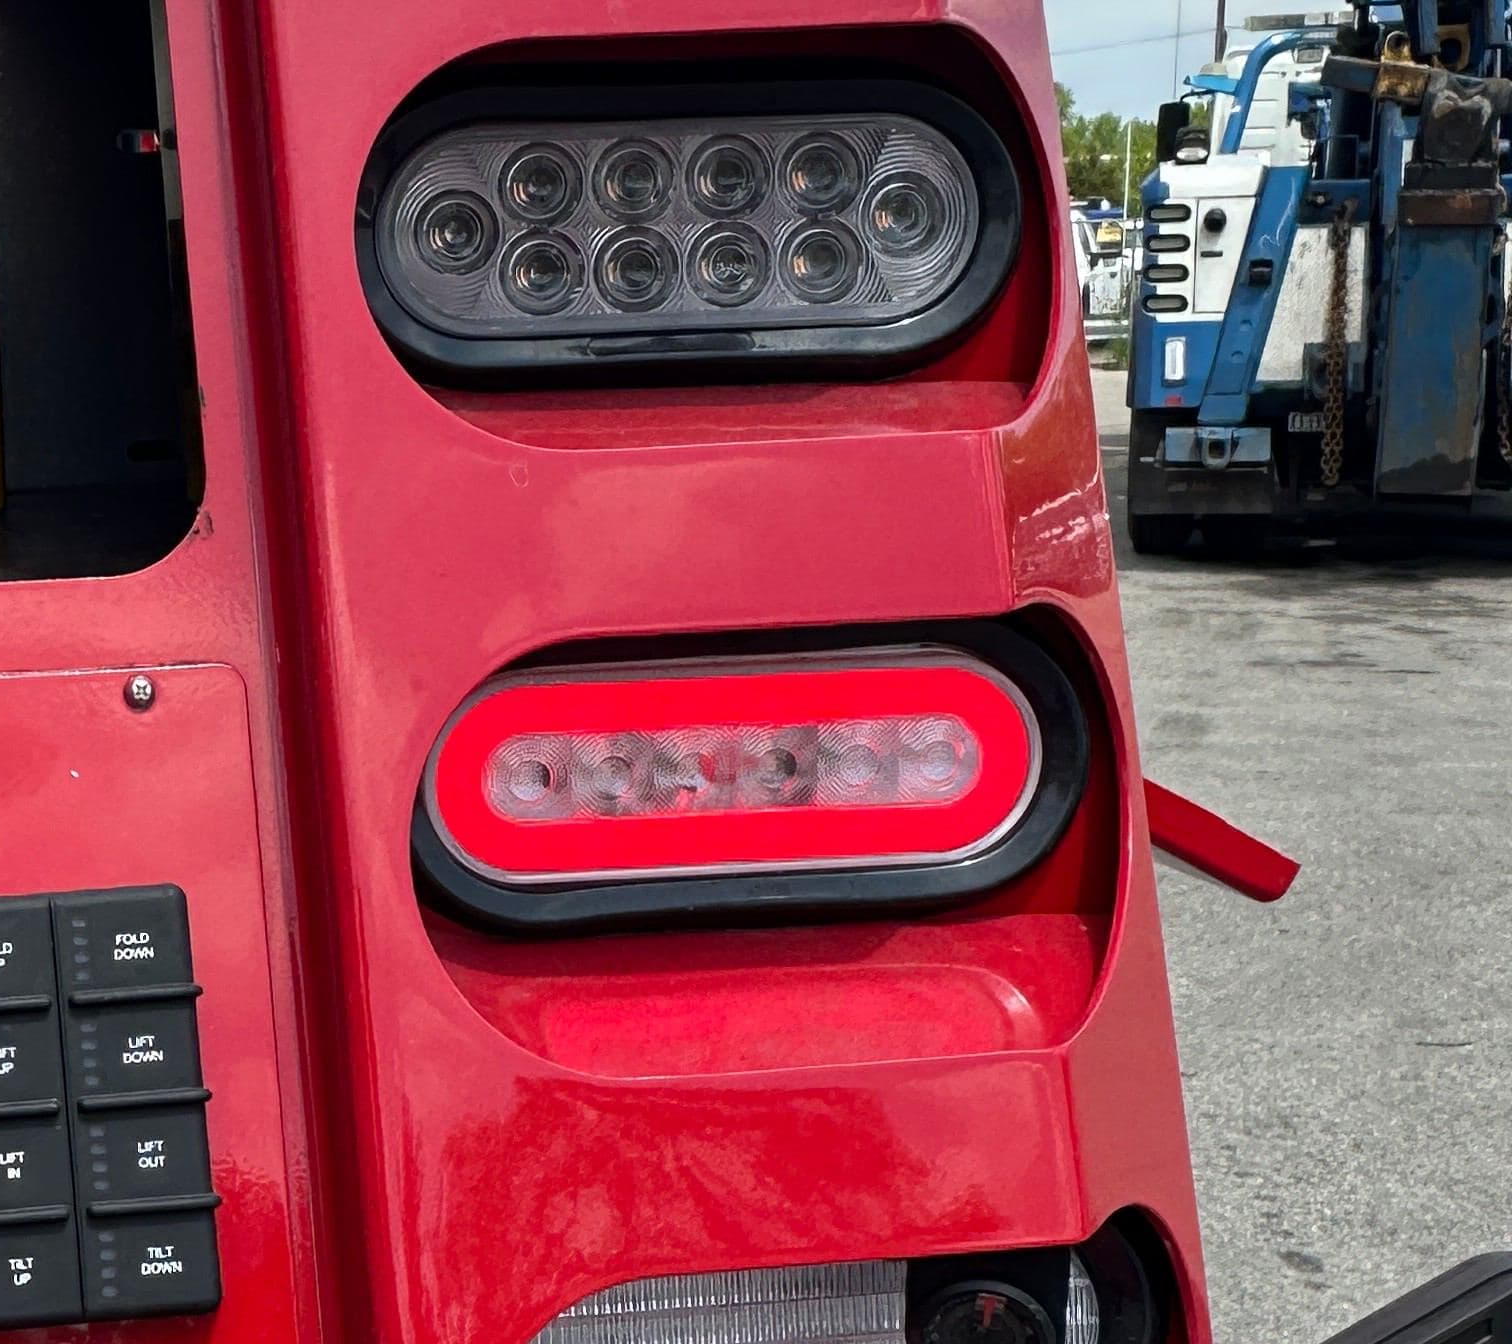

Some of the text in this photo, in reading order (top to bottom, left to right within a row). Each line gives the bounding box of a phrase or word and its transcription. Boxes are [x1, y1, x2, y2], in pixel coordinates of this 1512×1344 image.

[115, 933, 150, 945] FOLD
[113, 947, 155, 960] DOWN
[127, 1036, 156, 1048] LIFT
[122, 1050, 164, 1063] DOWN
[137, 1140, 165, 1153] LIFT
[137, 1156, 166, 1168] OUT
[6, 1167, 22, 1179] IN
[146, 1246, 175, 1258] TILT
[7, 1257, 34, 1270] TILT
[140, 1261, 183, 1275] DOWN
[13, 1273, 32, 1285] UP
